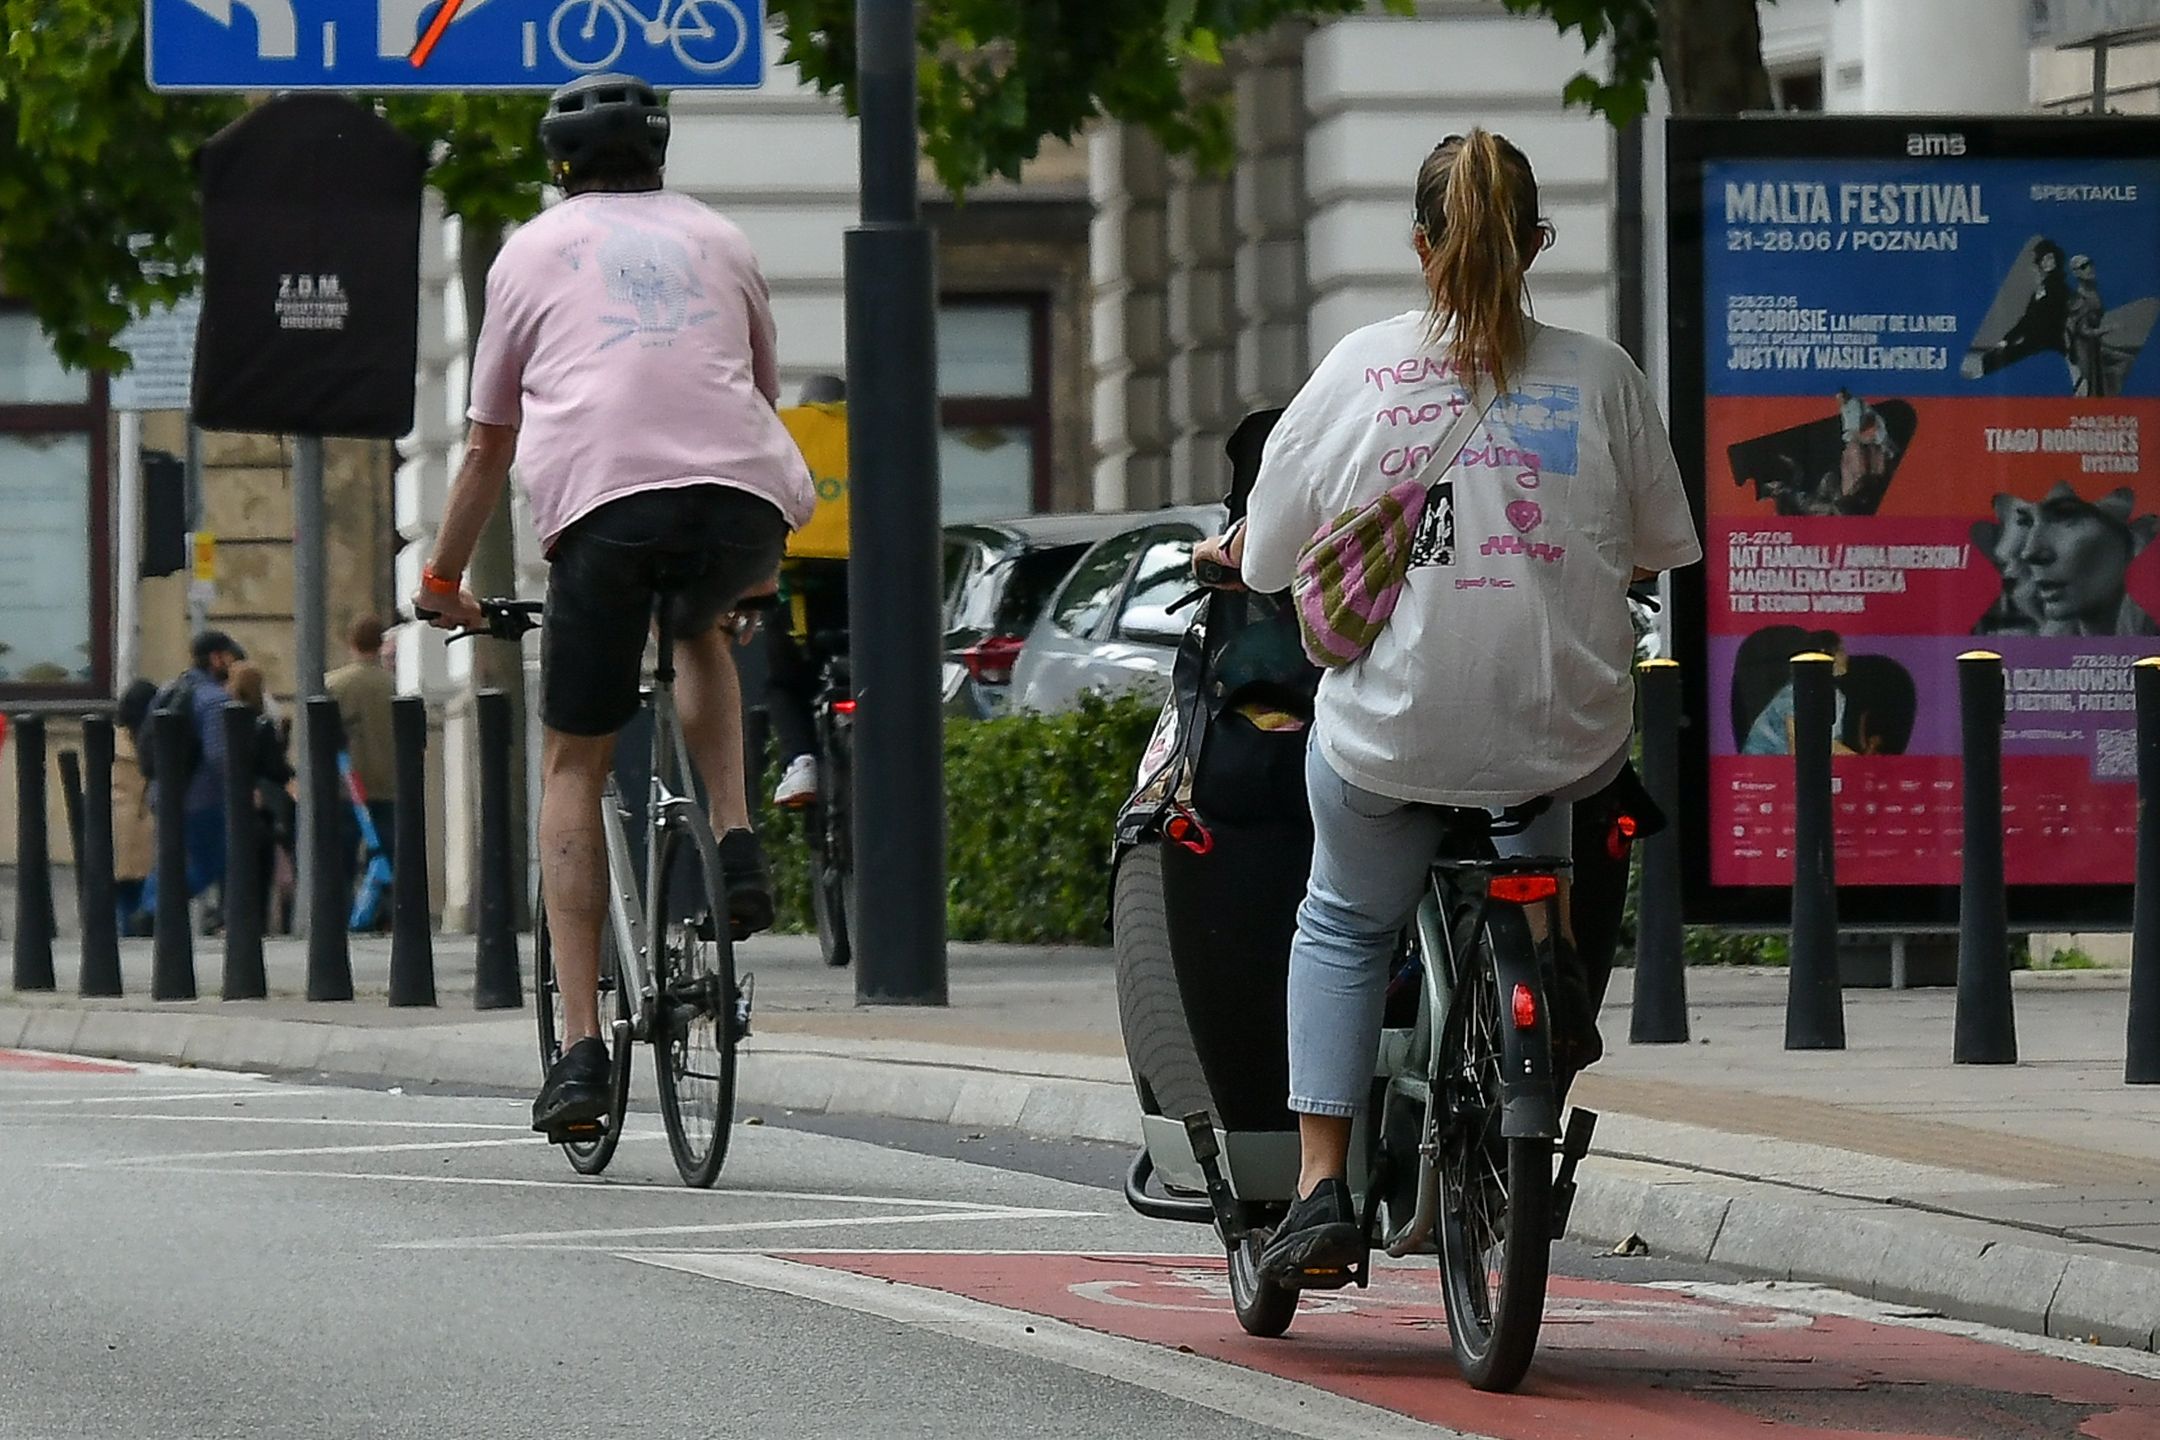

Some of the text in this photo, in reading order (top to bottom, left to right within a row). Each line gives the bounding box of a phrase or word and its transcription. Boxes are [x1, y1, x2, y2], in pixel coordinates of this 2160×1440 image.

[1907, 134, 1966, 156] ams
[1726, 183, 1989, 224] MALTA FESTIVAL
[2030, 185, 2137, 200] SPEKTAKLE
[1728, 231, 1831, 250] 21-28.06
[1853, 228, 1958, 250] POZNAŃ
[1728, 309, 1827, 331] COCOROSIE
[1728, 347, 1809, 369] JUSTYNY
[1365, 357, 1496, 391] nev
[1376, 394, 1468, 426] not
[1985, 428, 2038, 452] TIAGO
[1730, 546, 1758, 568] NAT
[1729, 570, 1828, 592] MAGDALENA
